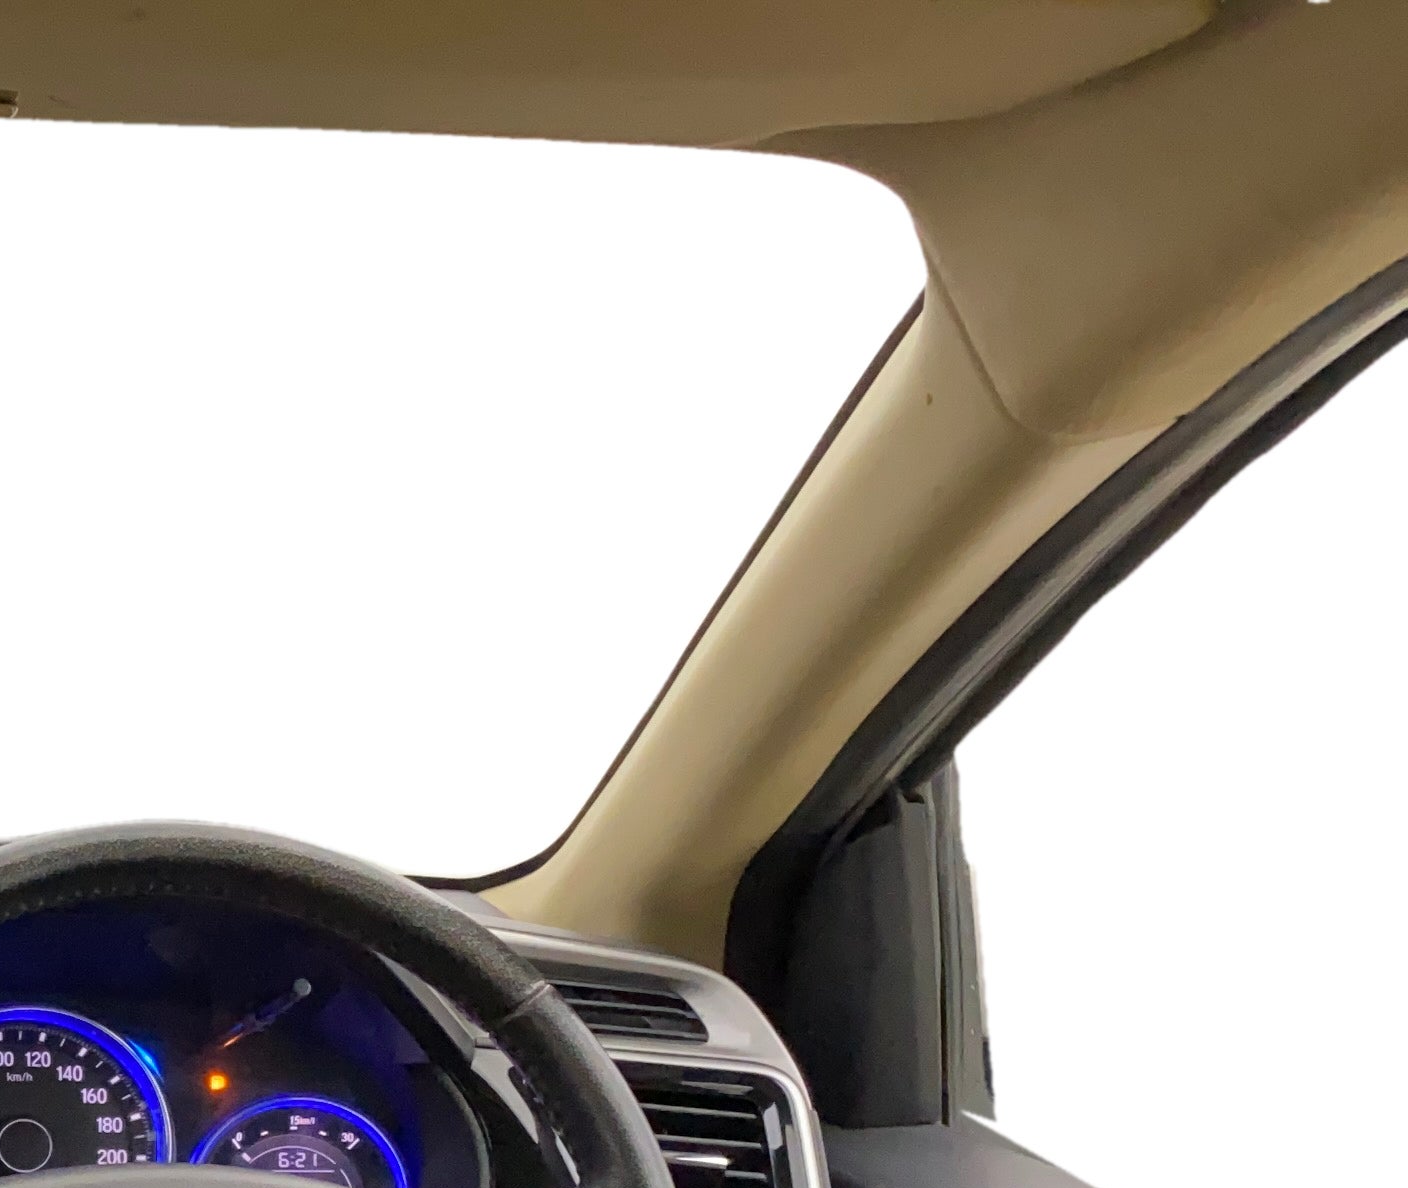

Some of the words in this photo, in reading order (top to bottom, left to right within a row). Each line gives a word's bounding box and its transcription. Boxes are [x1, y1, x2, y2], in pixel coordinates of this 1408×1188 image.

[25, 1051, 51, 1068] 120
[6, 1072, 33, 1083] km/h
[56, 1065, 83, 1082] 140
[81, 1088, 107, 1105] 160
[96, 1117, 123, 1134] 180
[235, 1132, 243, 1142] 0
[341, 1133, 354, 1143] 30
[97, 1149, 128, 1165] 200
[278, 1152, 318, 1169] 6:21
